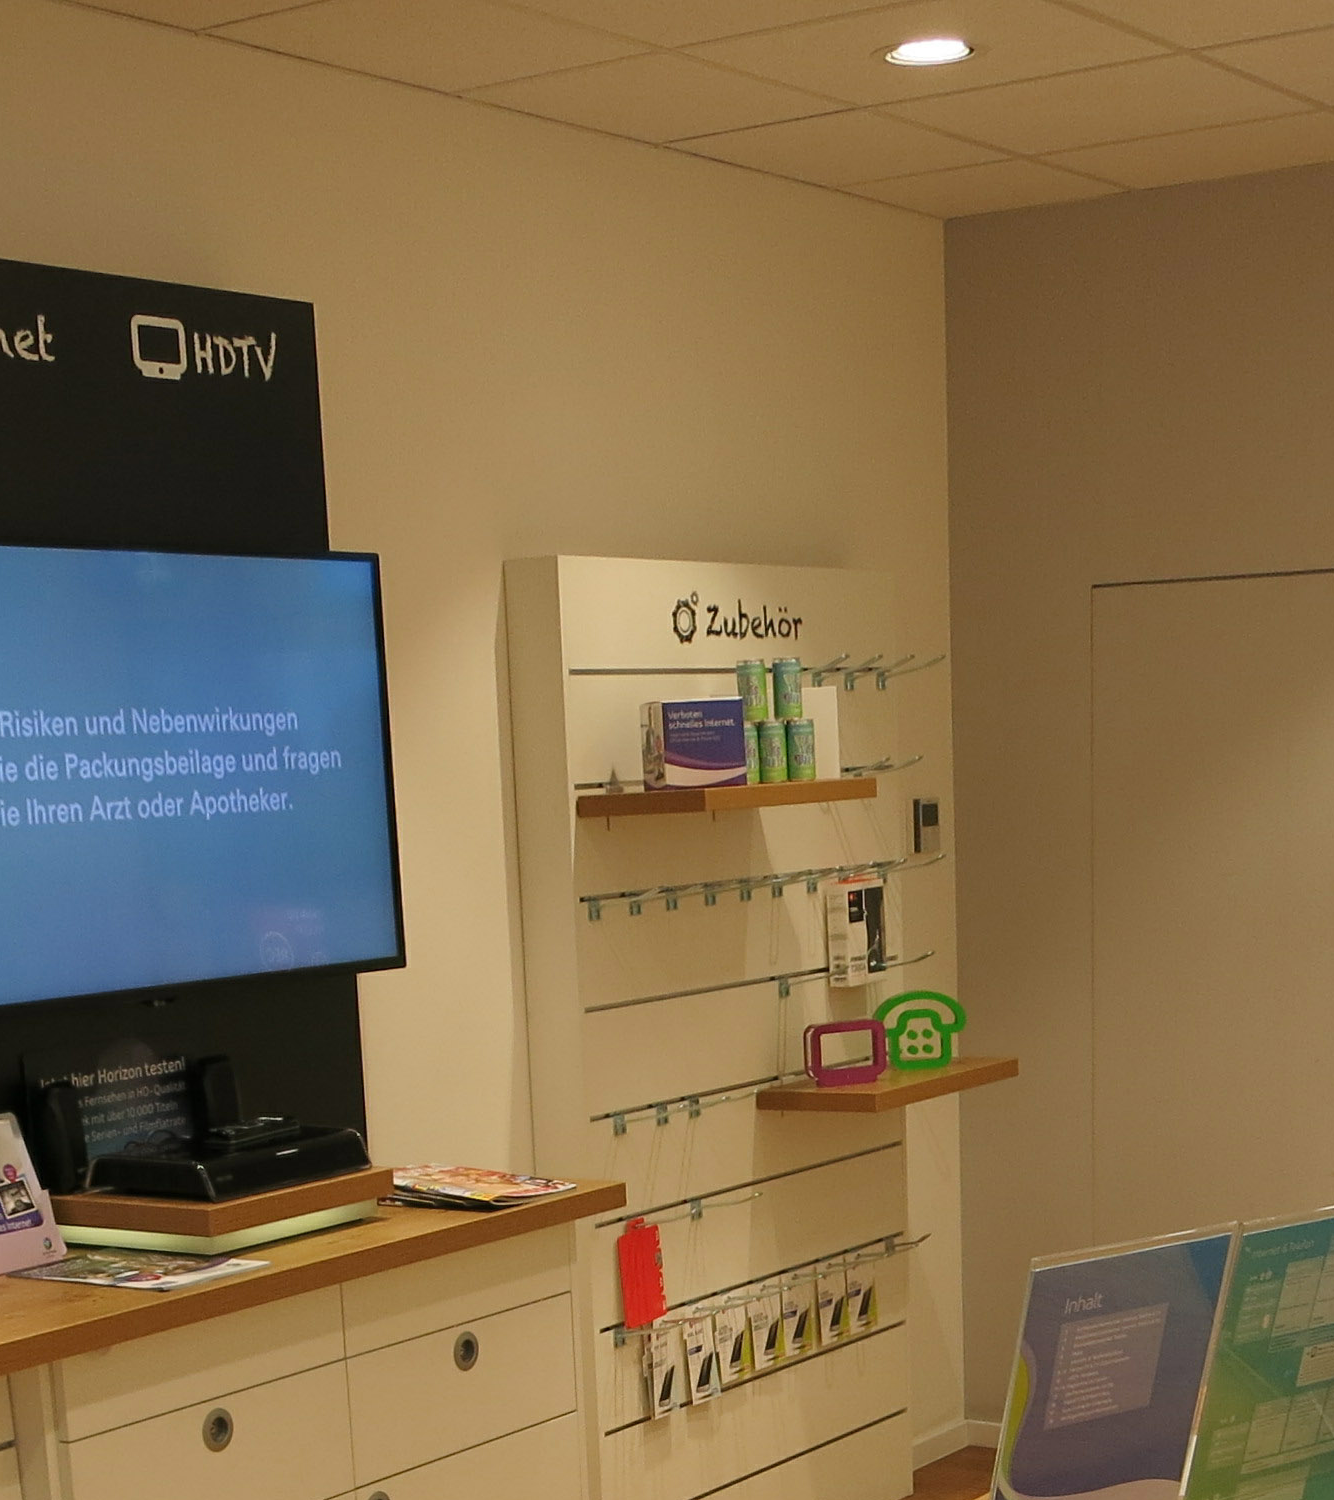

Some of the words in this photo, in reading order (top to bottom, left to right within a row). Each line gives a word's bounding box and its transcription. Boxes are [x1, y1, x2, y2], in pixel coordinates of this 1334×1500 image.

[192, 331, 278, 382] HDTV
[706, 599, 803, 641] Zubehör
[0, 709, 78, 739] Risiken
[85, 708, 126, 737] und
[132, 706, 299, 737] Nebenwirkungen
[25, 754, 59, 782] die
[65, 748, 236, 783] Packungsbeilage
[242, 747, 279, 773] und
[283, 745, 342, 775] fragen
[27, 797, 83, 826] Ihren
[89, 795, 133, 822] Arzt
[138, 792, 184, 819] oder
[189, 788, 294, 821] Apotheker.
[71, 1073, 95, 1089] hier
[97, 1065, 143, 1084] Horizon
[144, 1056, 186, 1077] testen!
[1064, 1292, 1104, 1314] Inhalt
